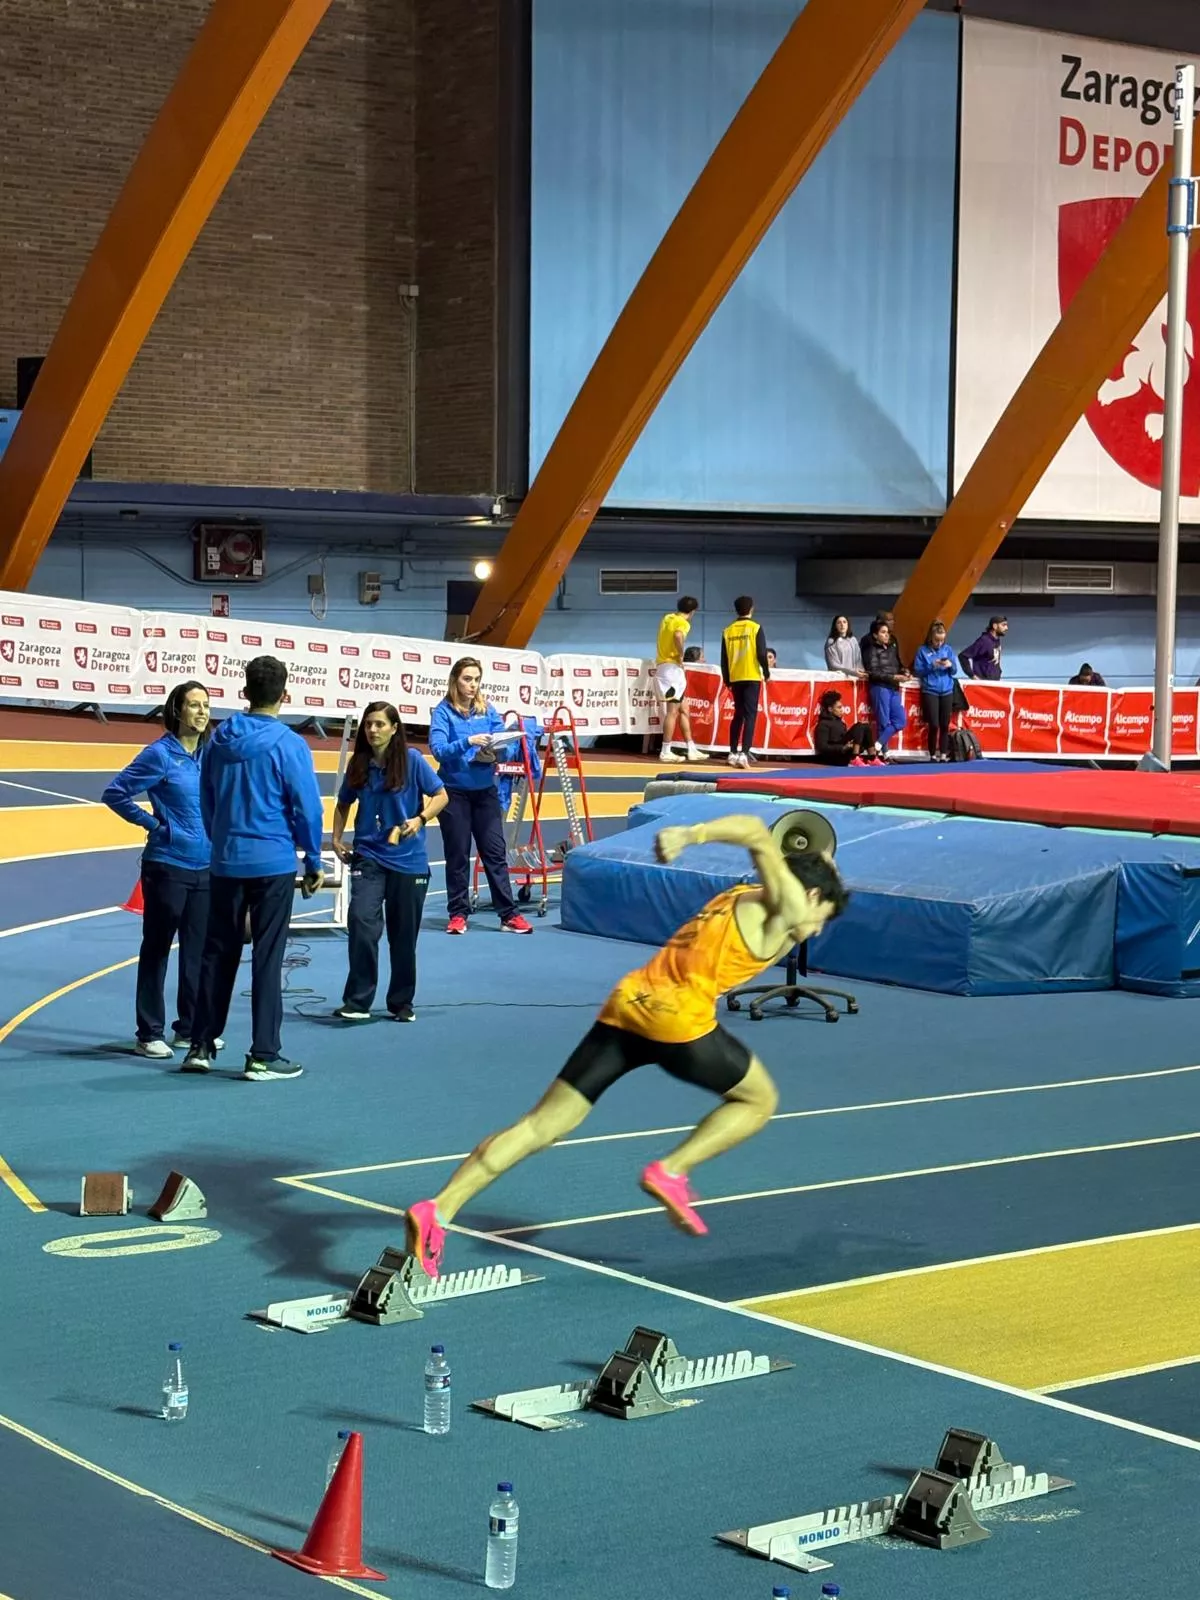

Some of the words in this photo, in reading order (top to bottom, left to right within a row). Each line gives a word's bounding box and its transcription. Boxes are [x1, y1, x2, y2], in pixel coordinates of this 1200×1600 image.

[1058, 116, 1175, 177] DEPO
[19, 641, 61, 656] Zaragoza
[92, 648, 131, 661] Zaragoza
[18, 653, 61, 667] DEPORTE
[161, 652, 196, 664] Zaragoz
[222, 656, 249, 669] Zarag
[91, 660, 131, 673] DEPORTE
[161, 663, 196, 674] DEPORT
[221, 667, 245, 678] DEPO
[289, 662, 328, 676] Zaragoza
[288, 673, 327, 687] DEPORTE
[353, 668, 391, 682] Zaragoza
[416, 674, 448, 688] Zaragoz
[353, 680, 390, 692] DEPORTE
[415, 685, 448, 697] DEPORT
[480, 682, 510, 693] aragoza
[482, 694, 509, 704] PORTE
[770, 702, 808, 716] Alcampo
[966, 706, 1006, 720] Alcampo
[1017, 708, 1054, 722] Alcampo
[1064, 710, 1102, 725] Alcampo
[1114, 713, 1150, 725] Alcampo
[1172, 713, 1194, 724] ampo
[306, 1304, 342, 1317] MONDO
[798, 1527, 840, 1545] MONDO
